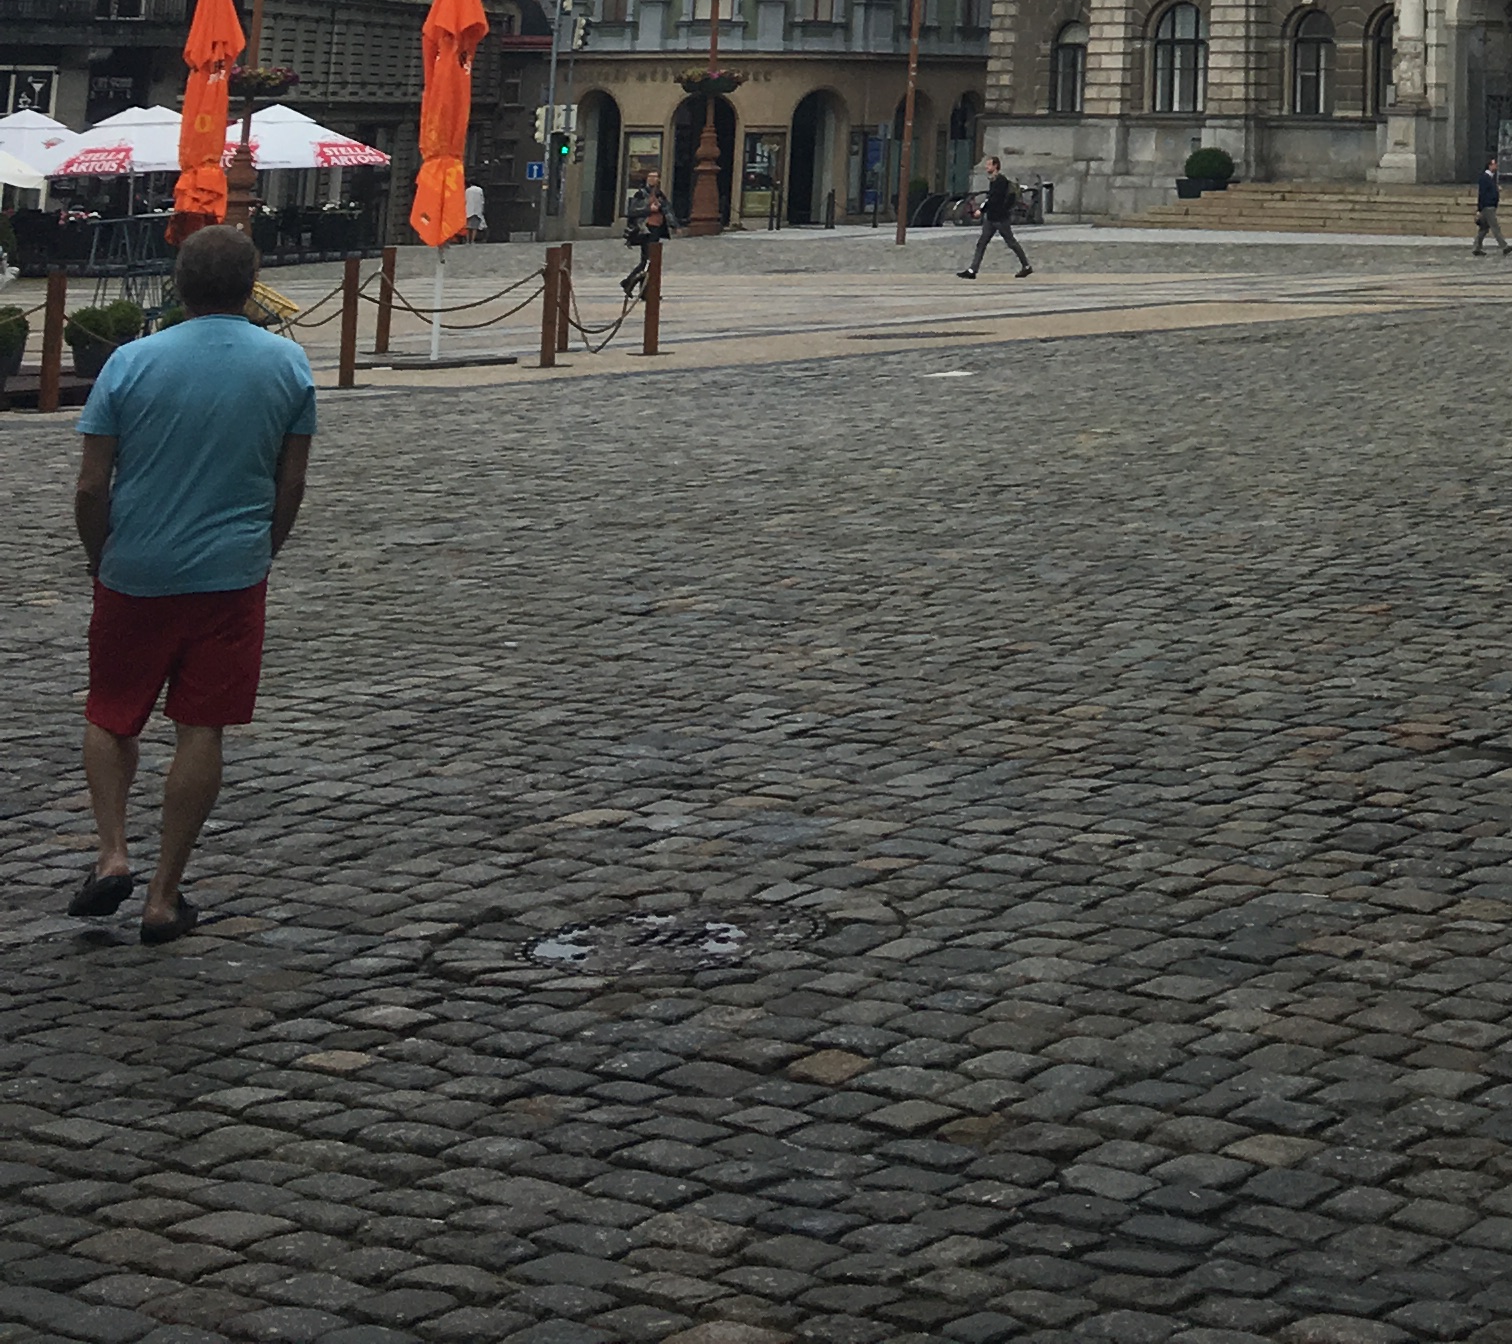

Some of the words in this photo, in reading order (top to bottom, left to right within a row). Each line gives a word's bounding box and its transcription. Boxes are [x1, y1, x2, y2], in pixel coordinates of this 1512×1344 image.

[322, 145, 377, 156] STELLA
[75, 151, 127, 163] STELLA
[330, 154, 385, 166] ARTOIS
[66, 160, 121, 173] ARTOIS
